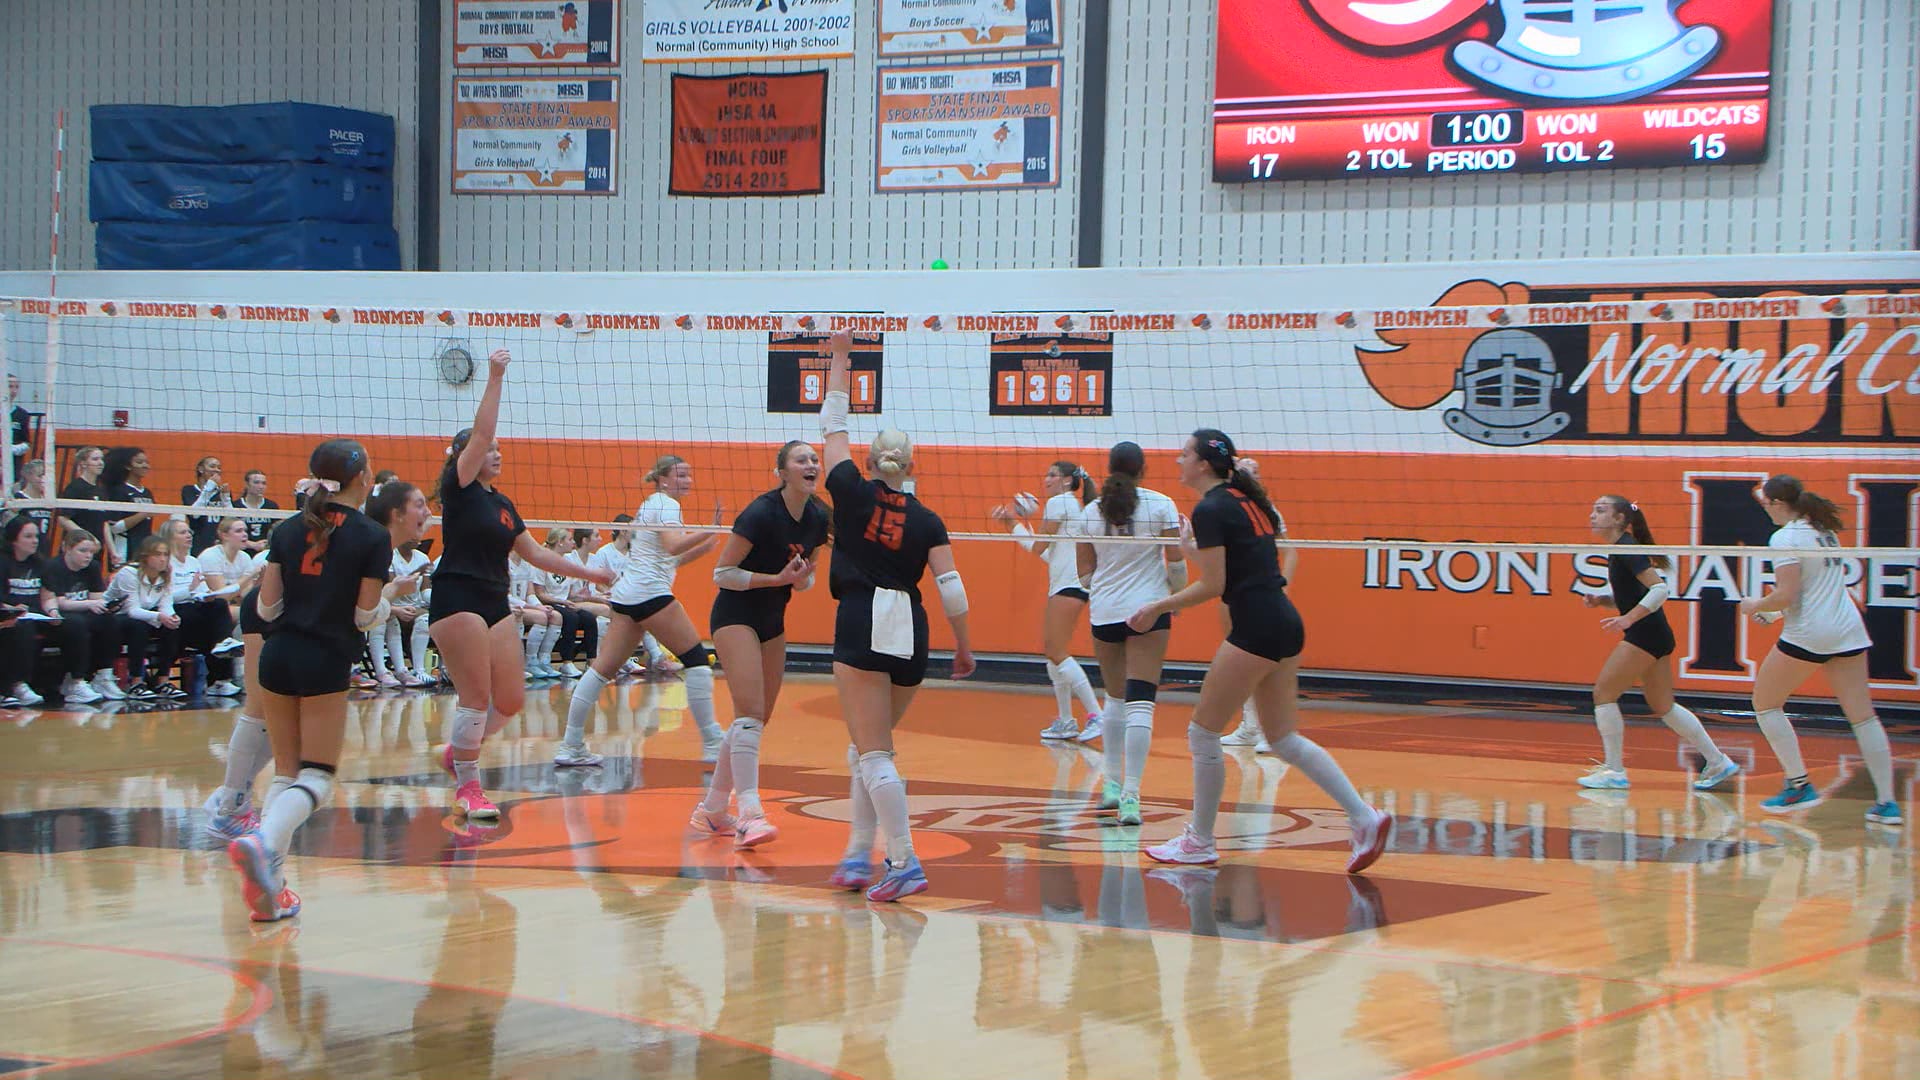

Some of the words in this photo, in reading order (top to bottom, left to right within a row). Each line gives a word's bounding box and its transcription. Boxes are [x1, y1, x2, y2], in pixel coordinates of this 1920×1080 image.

[479, 23, 499, 35] BOYS
[501, 23, 535, 34] FOOTBALL
[645, 22, 687, 36] GIRLS
[690, 19, 779, 34] VOLLEYBALL
[784, 15, 851, 32] 2001-2002
[909, 18, 931, 29] Boys
[933, 17, 965, 27] Soccer
[1030, 19, 1050, 33] 2014
[656, 41, 695, 53] Normal
[698, 39, 769, 54] (Community)
[772, 37, 797, 50] High
[800, 36, 839, 47] School
[886, 77, 897, 90] DO
[900, 76, 927, 89] WHAT'S
[929, 75, 954, 89] RIGHT!
[472, 86, 497, 98] WHAT'S
[500, 85, 523, 98] RIGHT!
[929, 93, 965, 107] STATE
[969, 92, 1007, 105] FINAL
[502, 103, 532, 115] STATE
[536, 103, 571, 114] FINAL
[887, 106, 998, 121] SPORTSMANSHIP
[1002, 103, 1051, 116] AWARD
[1643, 105, 1761, 128] WILDCATS
[462, 116, 562, 128] SPORTSMANSHIP
[567, 115, 612, 128] AWARD
[1446, 112, 1512, 143] 1:00
[1536, 112, 1597, 136] WON
[329, 128, 365, 143] PACER
[891, 129, 923, 140] Normal
[925, 127, 977, 140] Community
[1246, 125, 1296, 145] IRON
[1362, 121, 1419, 143] WON
[472, 140, 499, 149] Normal
[500, 140, 542, 151] Community
[901, 145, 922, 156] Girls
[924, 143, 967, 157] Volleyball
[1541, 141, 1591, 163] TOL
[1597, 139, 1615, 162] 2
[1689, 132, 1727, 160] 15
[474, 157, 494, 167] Girls
[496, 157, 536, 169] Volleyball
[705, 150, 746, 167] FINAL
[751, 149, 788, 166] FOUR
[1026, 157, 1047, 170] 2015
[1248, 153, 1279, 178] 17
[1346, 150, 1361, 171] 2
[1366, 148, 1413, 170] TOL
[1427, 149, 1517, 172] PERIOD
[588, 167, 607, 179] 2014
[128, 302, 197, 318] IRONMEN
[240, 305, 310, 322] IRONMEN
[353, 309, 425, 326] IRONMEN
[1374, 308, 1468, 327] IRONMEN
[1528, 303, 1629, 325] IRONMEN
[1693, 298, 1799, 320] IRONMEN
[468, 312, 541, 328] IRONMEN
[585, 313, 660, 330] IRONMEN
[706, 315, 783, 331] IRONMEN
[830, 316, 909, 332] IRONMEN
[957, 315, 1039, 331] IRONMEN
[1089, 314, 1175, 331] IRONMEN
[1227, 312, 1318, 330] IRONMEN
[1568, 322, 1869, 396] Normal
[250, 523, 262, 537] 3
[863, 505, 907, 551] 15
[1363, 537, 1553, 595] IRON
